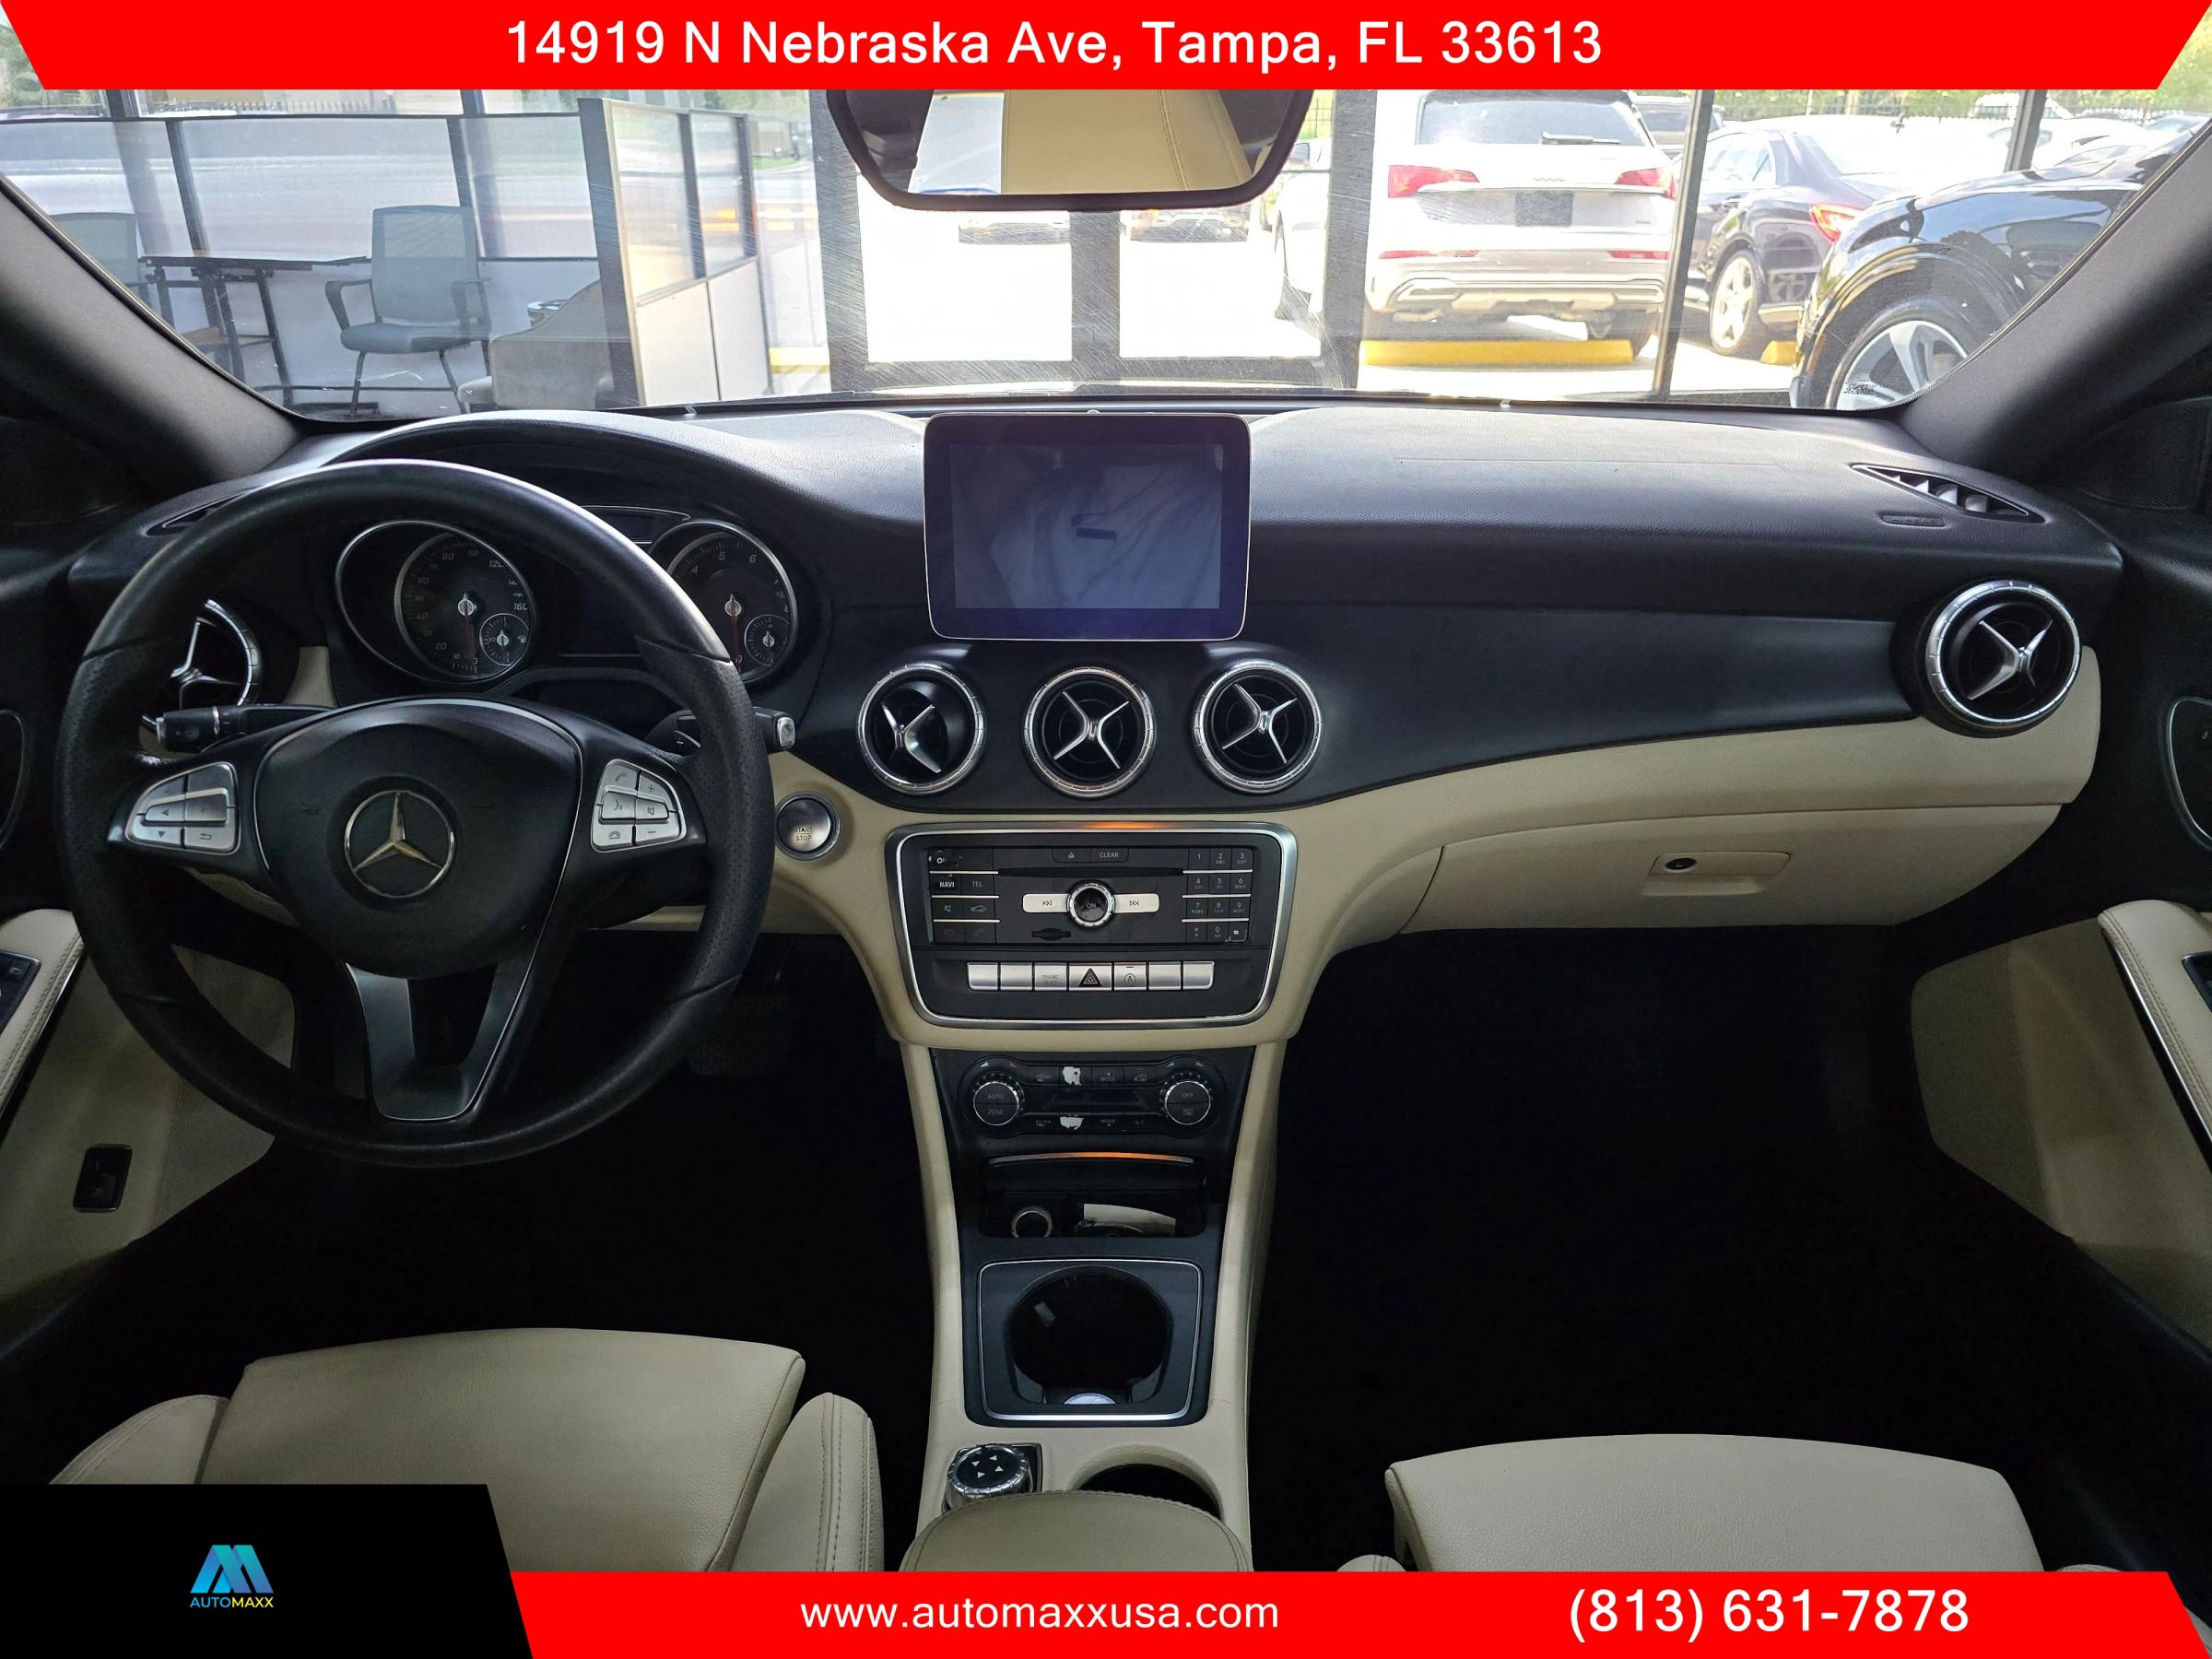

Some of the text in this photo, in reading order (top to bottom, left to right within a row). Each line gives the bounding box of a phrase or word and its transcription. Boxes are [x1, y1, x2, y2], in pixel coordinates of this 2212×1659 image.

[442, 552, 454, 561] 80
[718, 551, 727, 560] 5
[748, 554, 758, 564] 6
[691, 565, 700, 574] 4
[415, 612, 428, 620] 40
[435, 641, 447, 651] 20
[1239, 852, 1245, 860] 3
